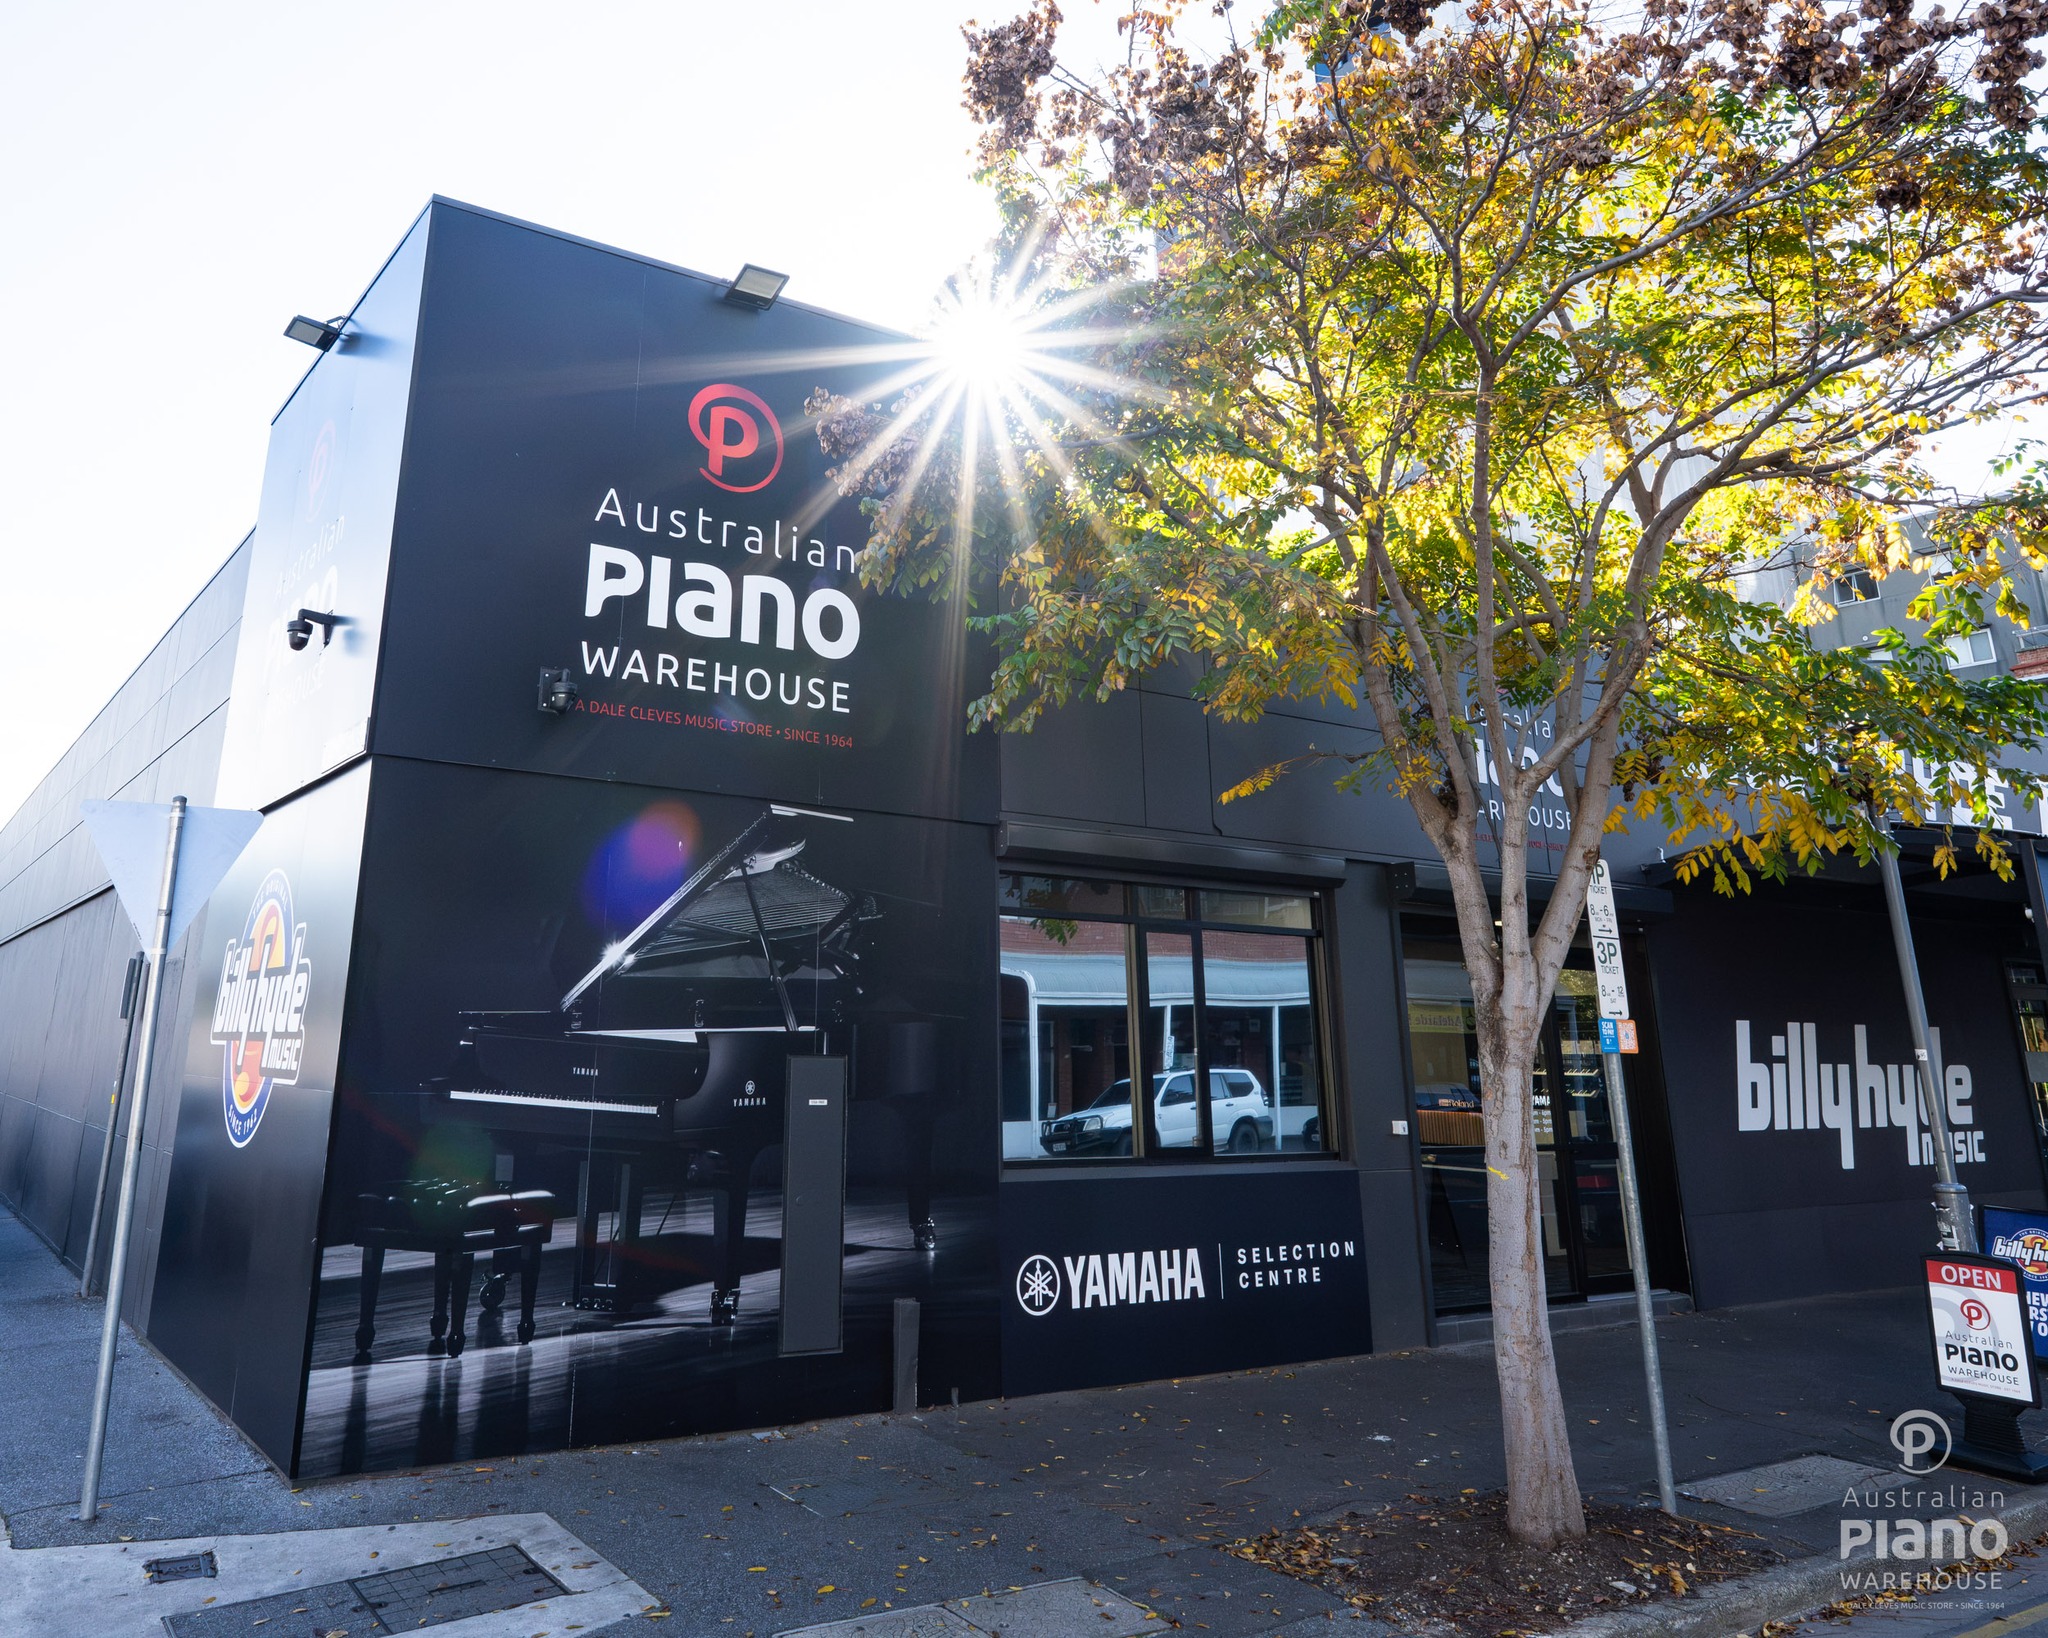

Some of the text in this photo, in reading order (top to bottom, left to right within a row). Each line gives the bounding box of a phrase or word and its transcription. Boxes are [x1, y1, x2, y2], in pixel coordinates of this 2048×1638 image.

[594, 487, 855, 574] Australian
[581, 640, 850, 714] WAREHOUSE
[575, 699, 853, 748] A DALE CLEVES MUSIC STORE SINCE 1964
[1589, 884, 1608, 895] TICKET
[1597, 941, 1617, 964] 3P
[1601, 965, 1620, 975] TICKET
[573, 1067, 598, 1076] YAMAHA
[733, 1097, 767, 1107] YAMAHA
[1449, 1099, 1475, 1108] Roland
[1063, 1240, 1355, 1309] YAMAHA SELECTION
[1238, 1266, 1321, 1289] CENTRE
[1940, 1264, 2002, 1290] OPEN
[1945, 1330, 2013, 1350] Australian
[1947, 1365, 2020, 1386] WAREHOUSE
